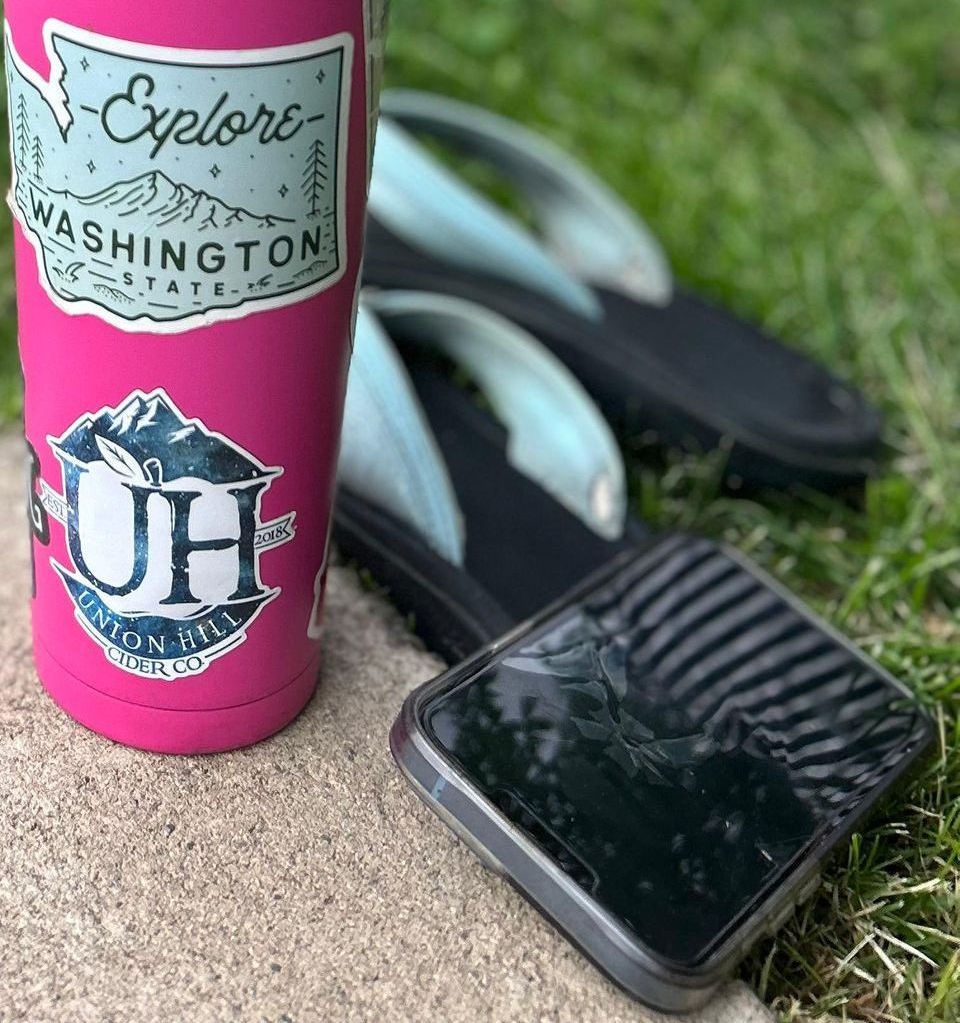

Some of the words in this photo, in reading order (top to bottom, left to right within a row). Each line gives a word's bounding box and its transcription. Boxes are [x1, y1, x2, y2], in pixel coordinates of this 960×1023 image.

[101, 73, 303, 159] Explore
[28, 187, 321, 274] WASHINGTON
[123, 271, 225, 297] STATE
[56, 451, 267, 605] UH
[255, 526, 283, 546] 2018
[77, 589, 165, 654] UNION
[177, 610, 244, 652] HILL
[107, 646, 171, 677] CIDER
